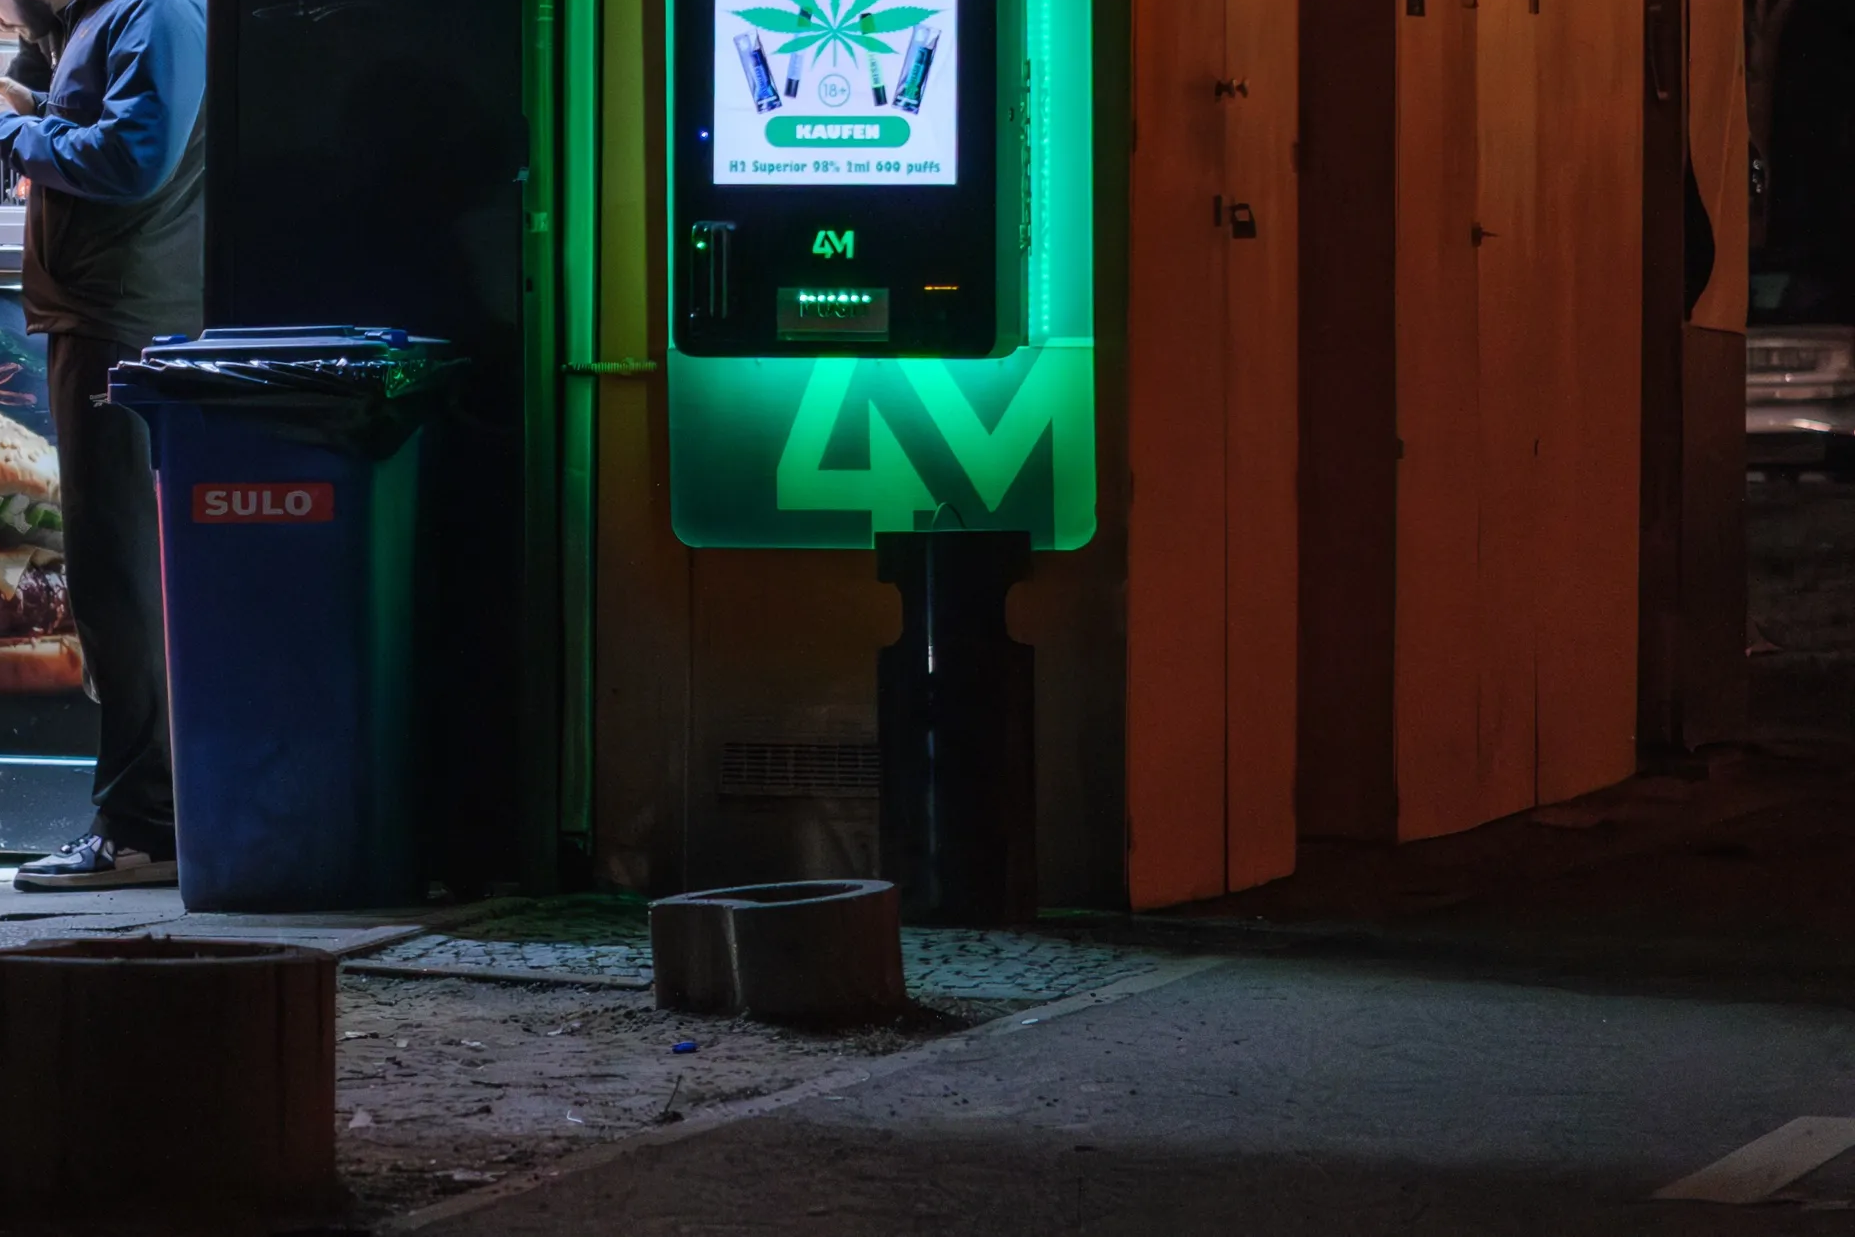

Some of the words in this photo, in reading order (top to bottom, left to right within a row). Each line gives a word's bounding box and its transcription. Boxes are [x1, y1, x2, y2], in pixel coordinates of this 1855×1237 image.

[822, 83, 847, 98] 18+
[795, 123, 881, 140] KAUFEN
[752, 160, 808, 175] Superior
[907, 160, 941, 176] puffs
[812, 229, 856, 260] 4M
[204, 488, 313, 517] SULO
